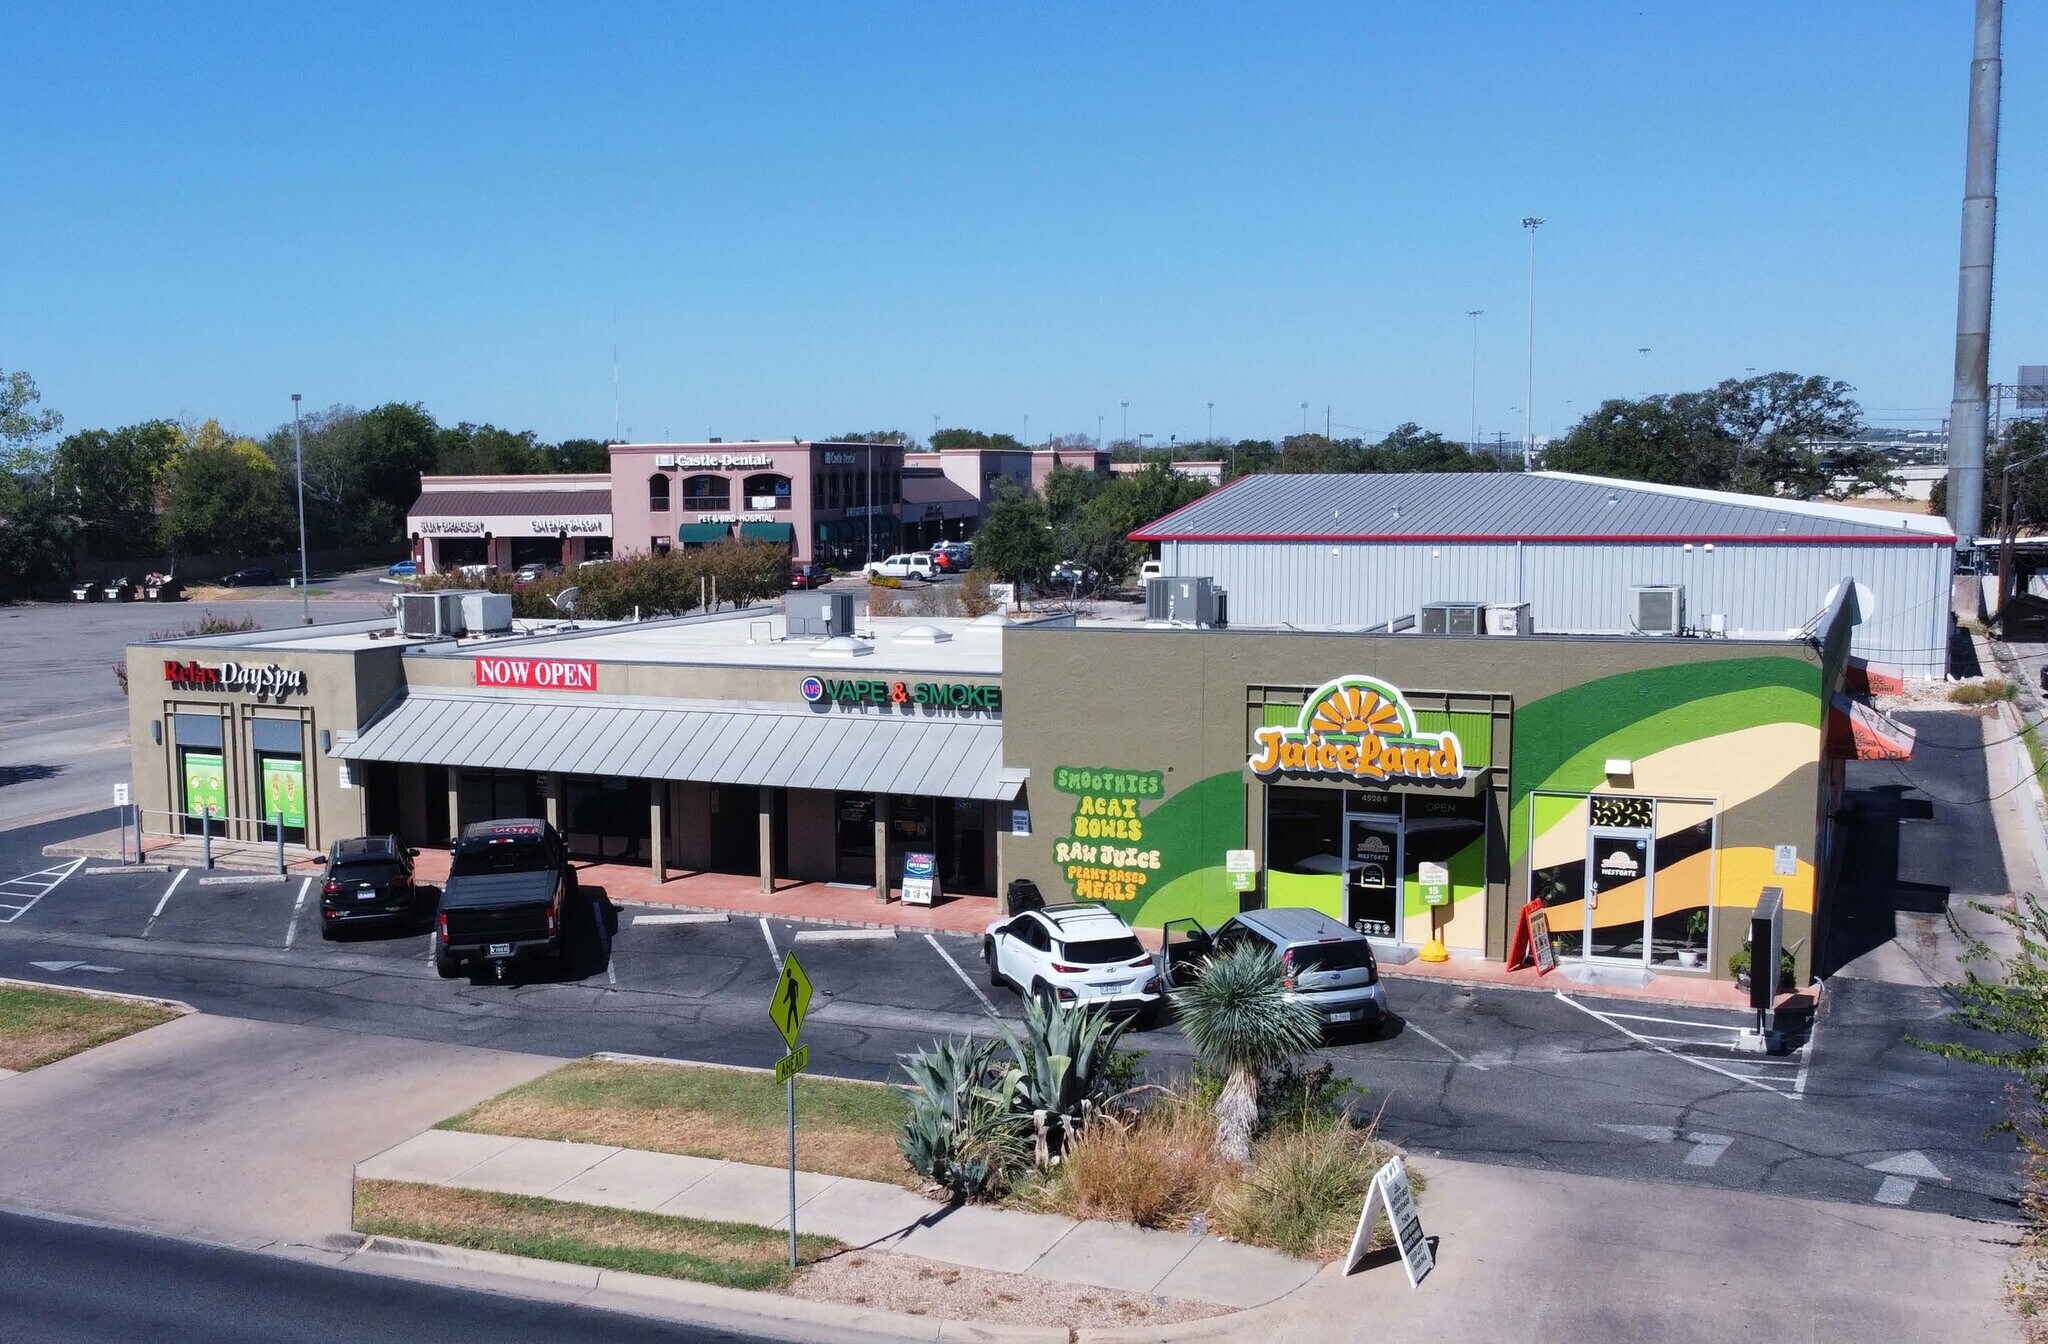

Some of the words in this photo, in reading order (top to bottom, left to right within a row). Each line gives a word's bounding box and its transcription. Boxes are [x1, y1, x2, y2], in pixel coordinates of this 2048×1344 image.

[676, 454, 718, 466] Castle
[722, 454, 766, 466] Dental
[697, 514, 711, 523] PET
[720, 514, 736, 523] BIRD
[739, 514, 774, 523] HOSPITAL
[163, 660, 220, 684] Relax
[479, 659, 528, 685] NOW
[534, 662, 593, 688] OPEN
[804, 684, 820, 696] AVS
[827, 680, 886, 703] VAPE
[892, 681, 909, 704] &
[914, 684, 1000, 707] SMOKE
[1253, 731, 1460, 778] JuiceLand
[1057, 769, 1159, 795] SMOOTHIES
[1080, 795, 1137, 819] ACAI
[1362, 794, 1382, 803] 4526
[1426, 802, 1456, 812] OPEN
[1074, 816, 1143, 841] BOWLS
[1056, 841, 1097, 864] RAW
[1100, 845, 1161, 870] JUICE
[1357, 853, 1389, 861] WESTGATE
[1067, 865, 1108, 882] PLANT
[1109, 868, 1148, 885] BASED
[1602, 868, 1637, 877] WESTGATE
[1076, 879, 1138, 901] MEALS
[1428, 886, 1439, 895] 15
[782, 1052, 803, 1078] AHEAD
